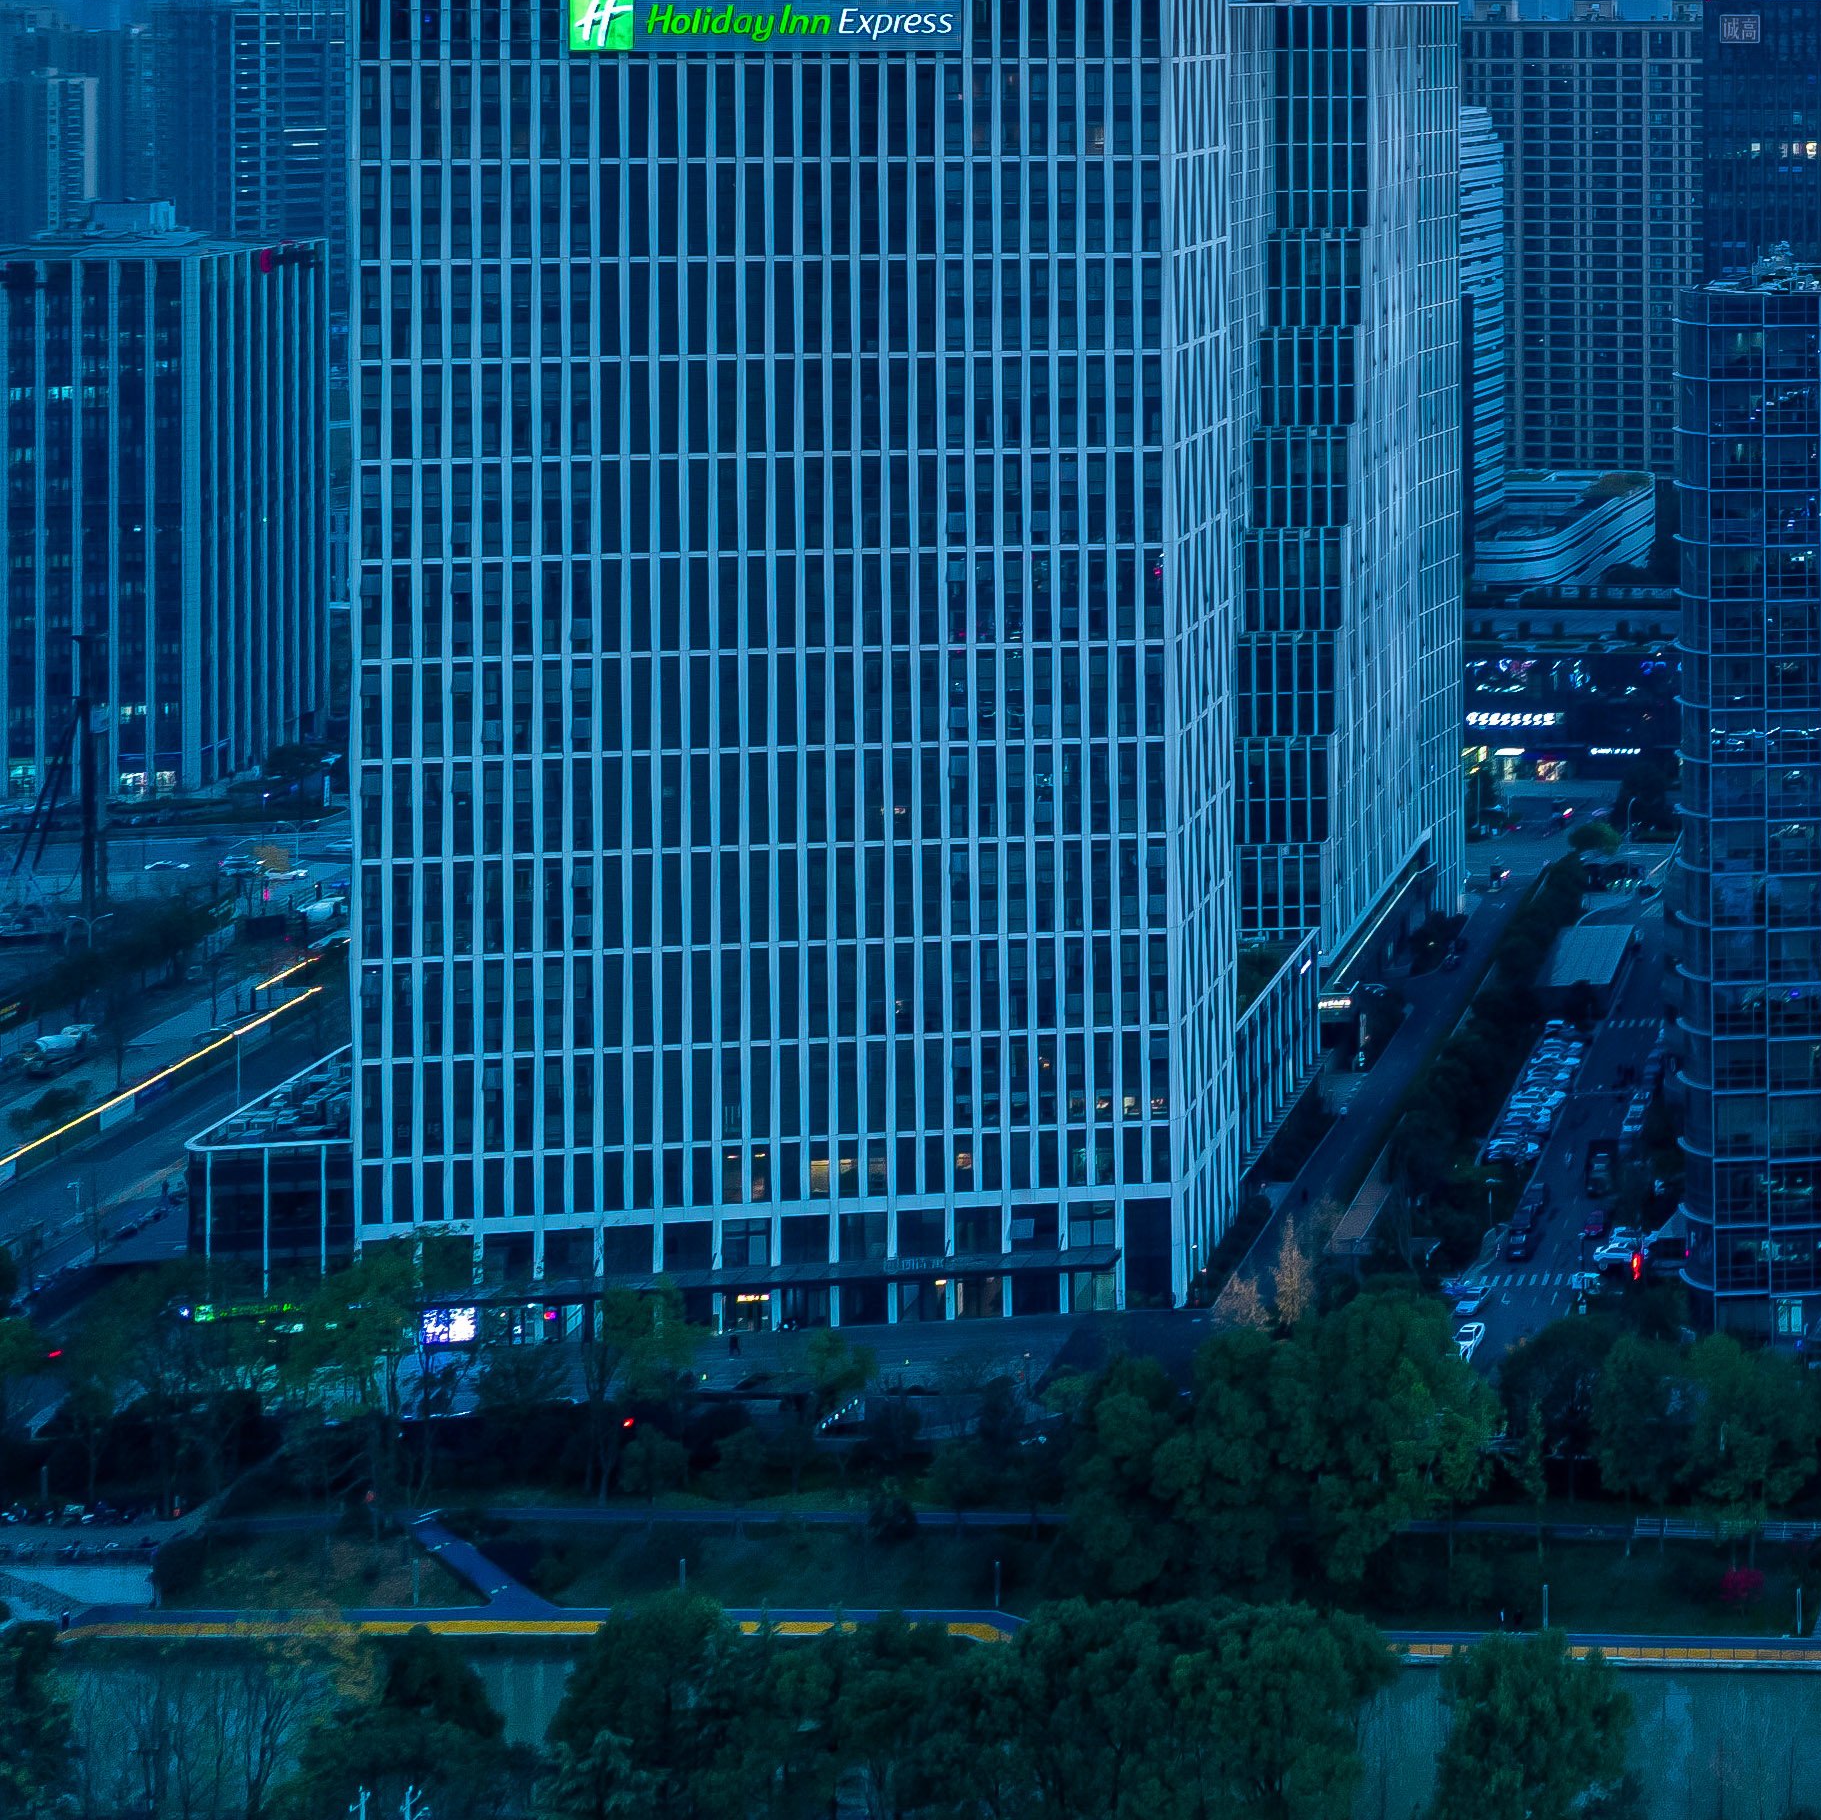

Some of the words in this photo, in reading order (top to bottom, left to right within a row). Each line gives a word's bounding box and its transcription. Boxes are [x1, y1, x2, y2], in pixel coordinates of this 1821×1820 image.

[646, 3, 777, 42] Holiday
[779, 4, 832, 36] Inn
[838, 7, 954, 40] Express
